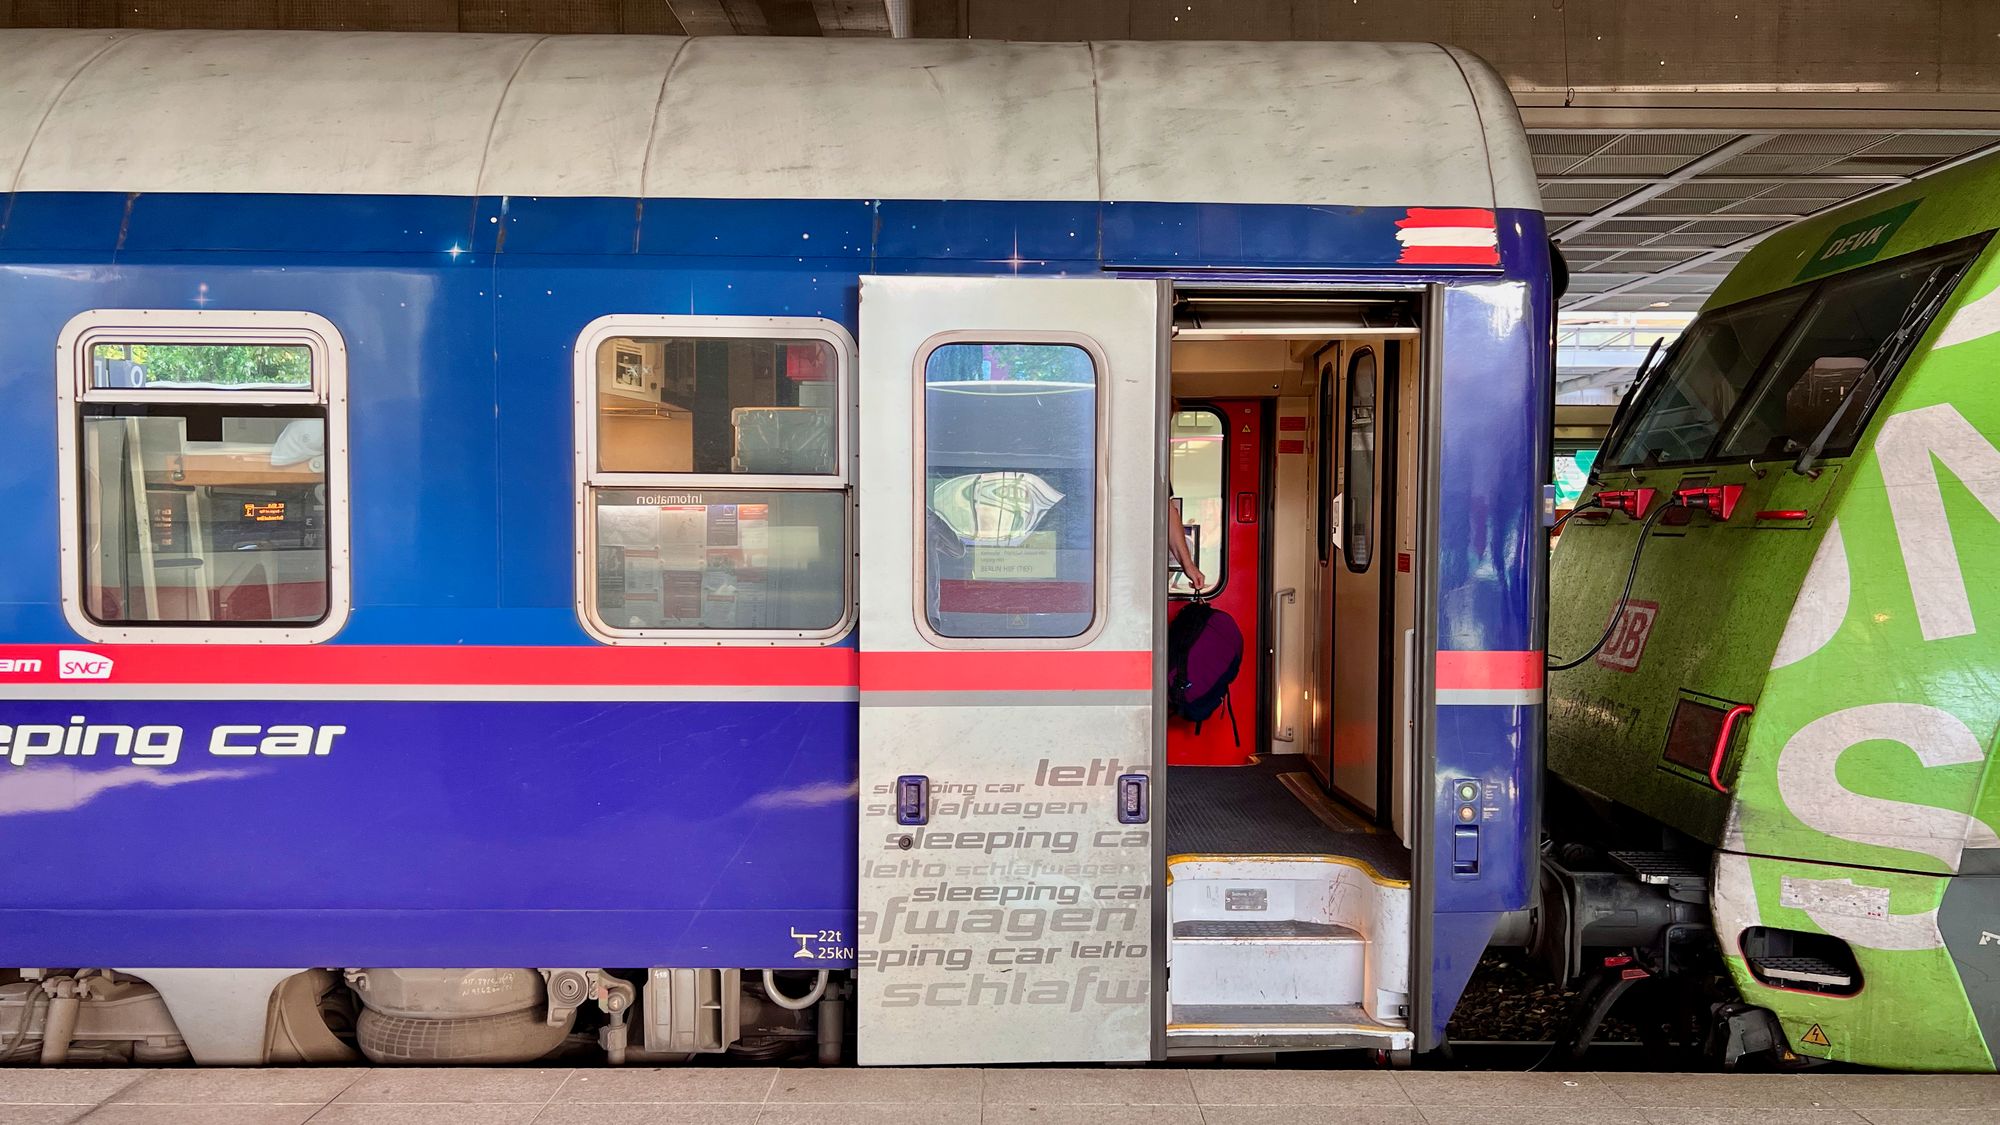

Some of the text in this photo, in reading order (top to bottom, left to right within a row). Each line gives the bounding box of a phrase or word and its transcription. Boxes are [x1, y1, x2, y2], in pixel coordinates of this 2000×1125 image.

[1819, 222, 1892, 261] DEVK
[63, 661, 109, 675] SNCF
[0, 715, 348, 767] ping car
[873, 781, 1025, 796] slping car
[865, 796, 1088, 819] sclafwagen
[883, 826, 1078, 855] sleeping
[863, 859, 1136, 879] letto schlafwagen
[911, 881, 1081, 906] sleeping
[818, 930, 842, 943] 22t
[818, 946, 855, 960] 25kN
[987, 946, 1063, 965] car
[1070, 940, 1149, 959] letto
